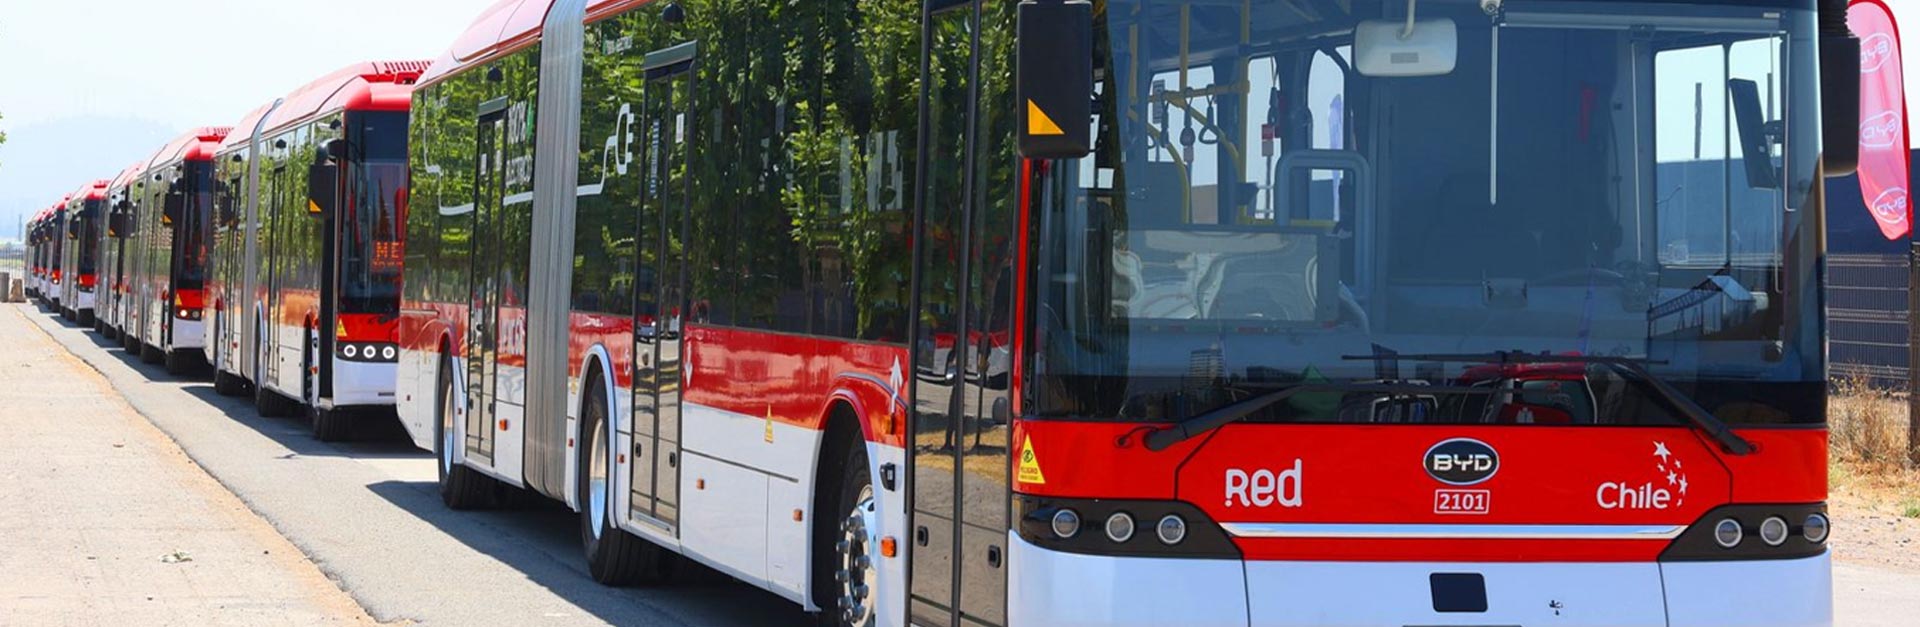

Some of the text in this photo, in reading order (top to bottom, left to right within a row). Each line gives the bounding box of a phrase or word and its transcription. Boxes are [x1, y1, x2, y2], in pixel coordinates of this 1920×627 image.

[376, 241, 404, 254] ME
[1433, 454, 1492, 471] BYD
[1225, 458, 1302, 507] Red
[1438, 493, 1485, 510] 2101
[1596, 481, 1671, 509] Chile
